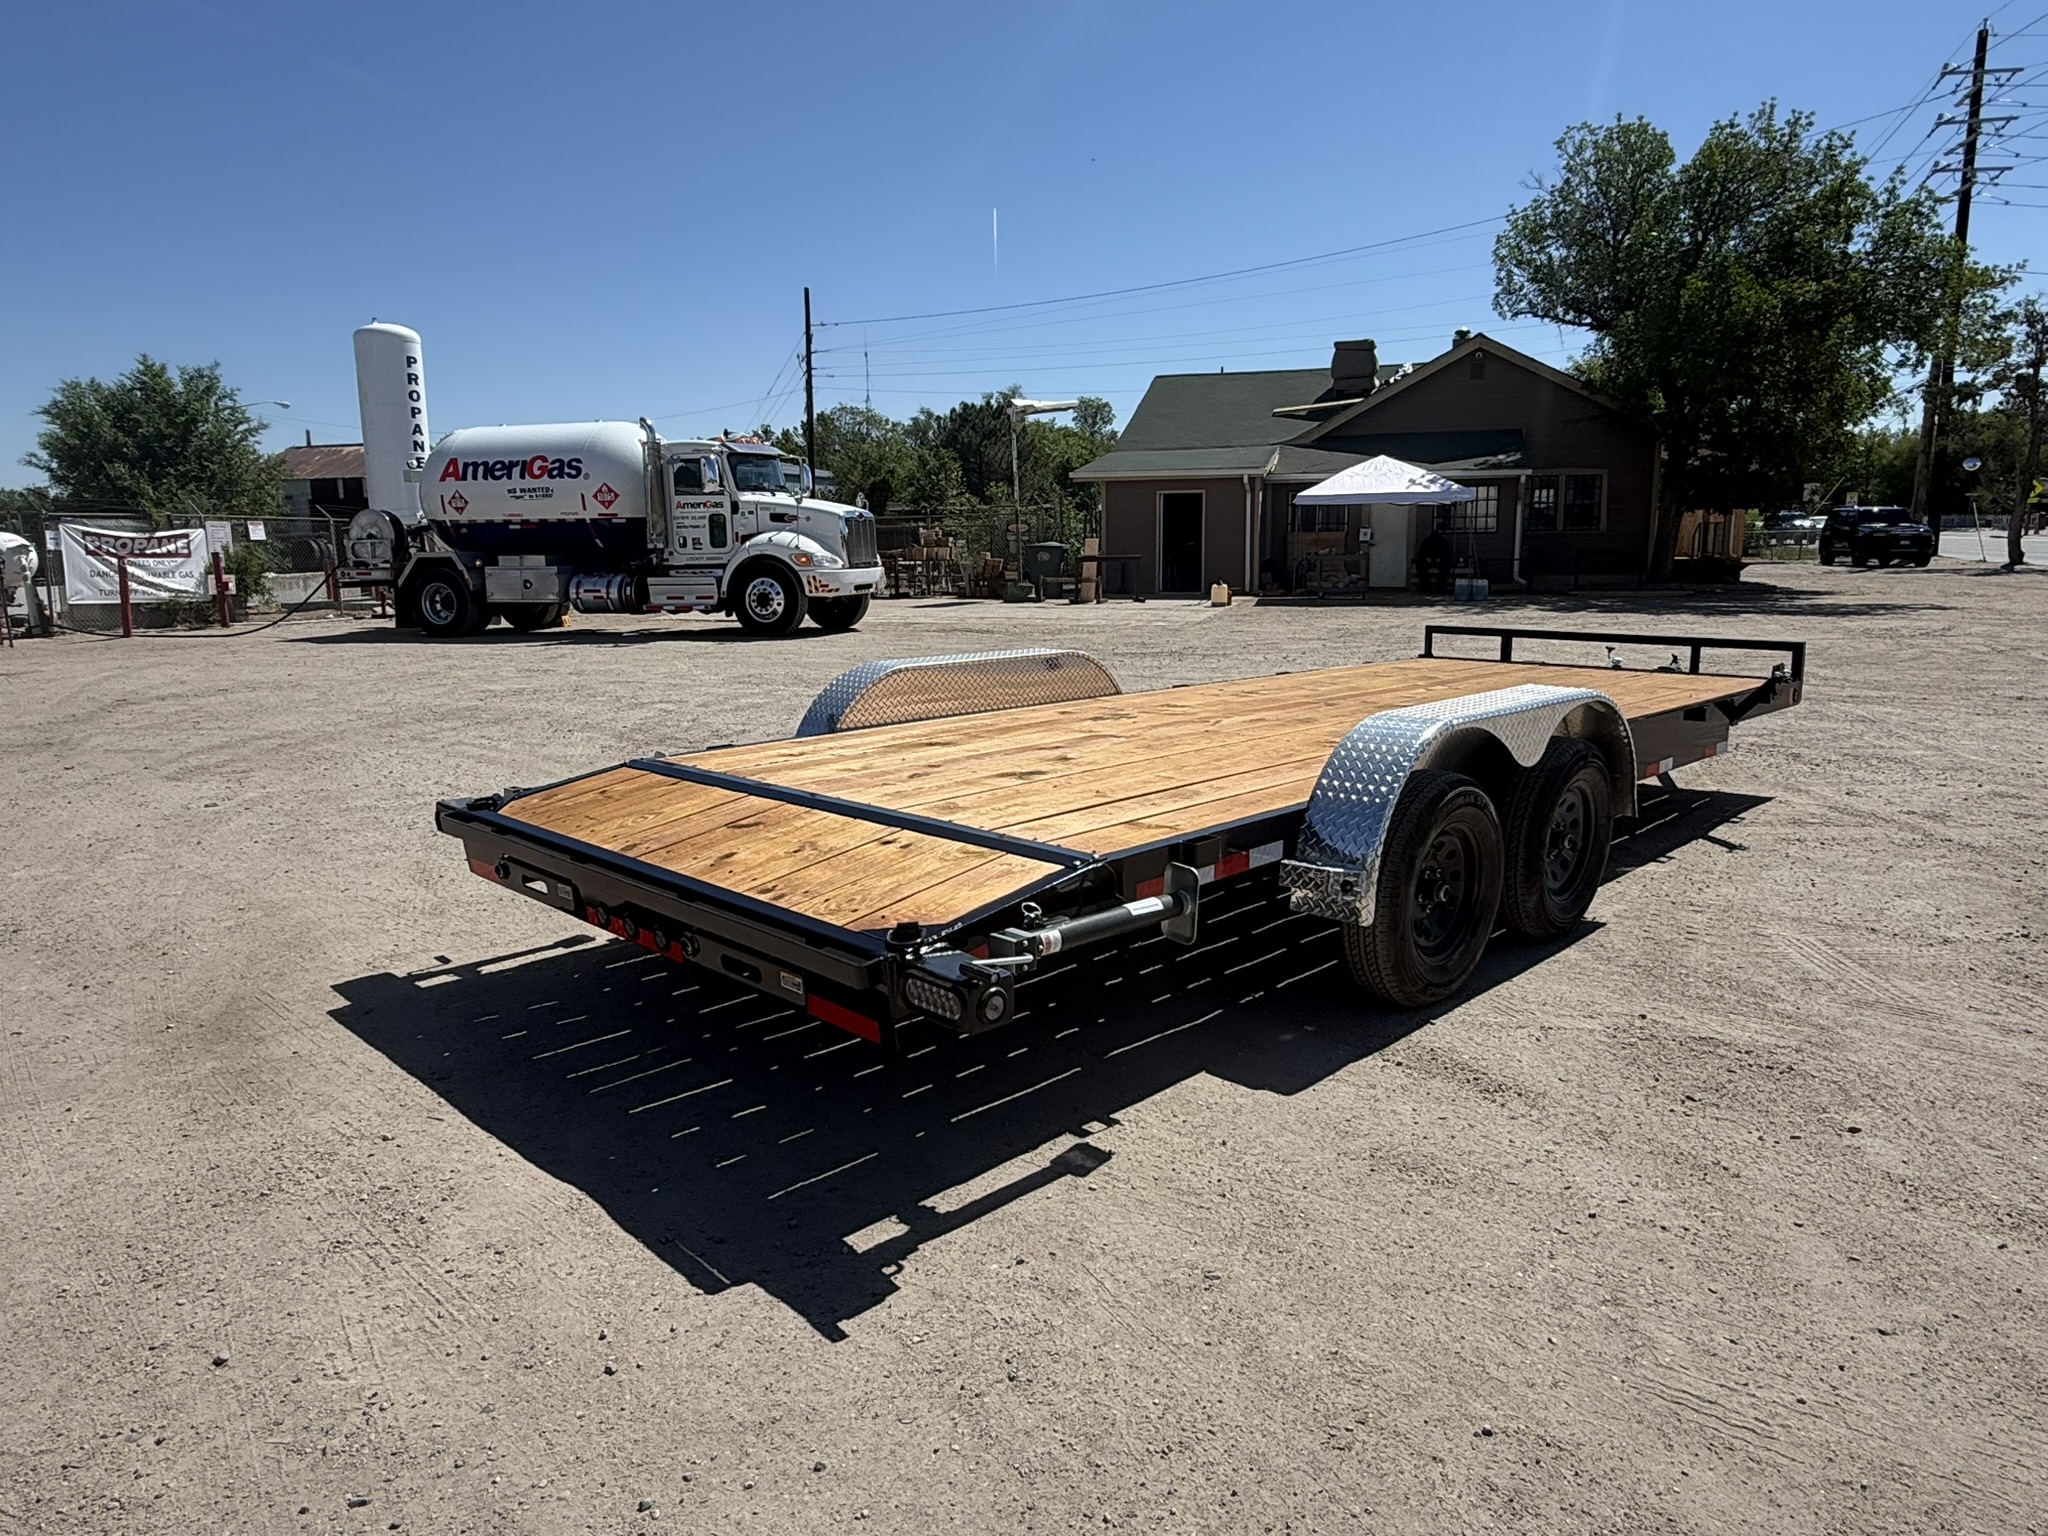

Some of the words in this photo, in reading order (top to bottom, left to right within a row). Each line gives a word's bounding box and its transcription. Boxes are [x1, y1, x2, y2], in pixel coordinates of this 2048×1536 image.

[405, 355, 425, 469] PROPANE
[439, 455, 583, 482] AmeriGas
[676, 500, 724, 510] AmeriGas
[85, 535, 189, 554] PROPANE
[178, 570, 194, 579] GAS
